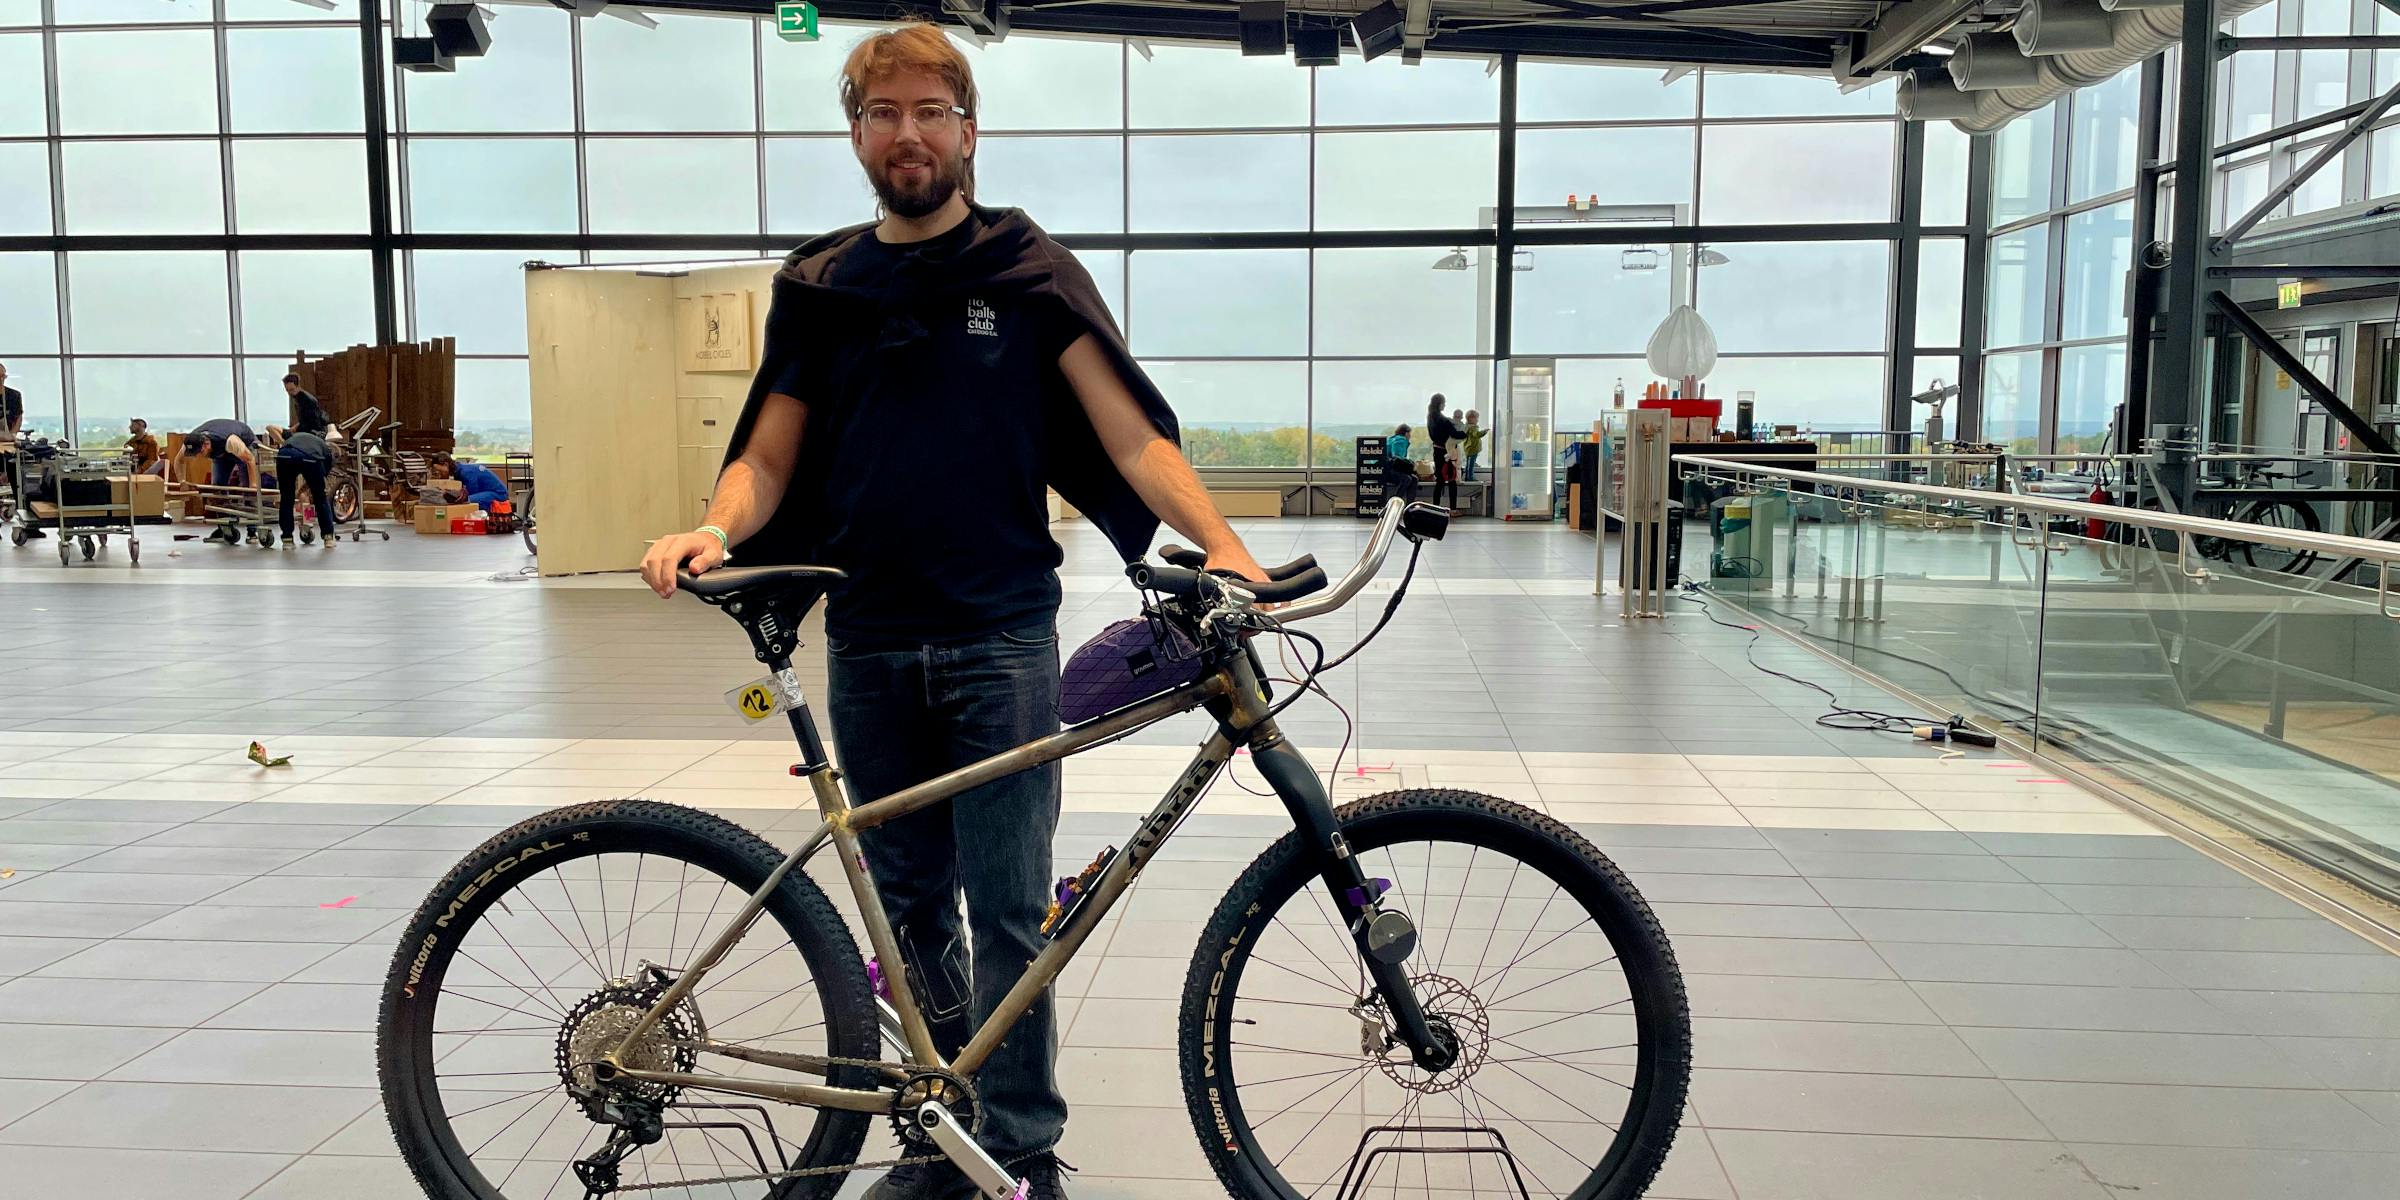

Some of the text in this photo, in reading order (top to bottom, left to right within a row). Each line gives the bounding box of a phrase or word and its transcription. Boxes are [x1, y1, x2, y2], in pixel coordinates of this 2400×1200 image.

[968, 306, 996, 320] balls
[968, 317, 994, 331] club
[743, 689, 770, 712] 12
[407, 932, 438, 986] vittoria
[436, 841, 566, 928] MEZCAL
[1203, 926, 1247, 1078] MEZCAL
[1208, 1087, 1232, 1145] vittoria
